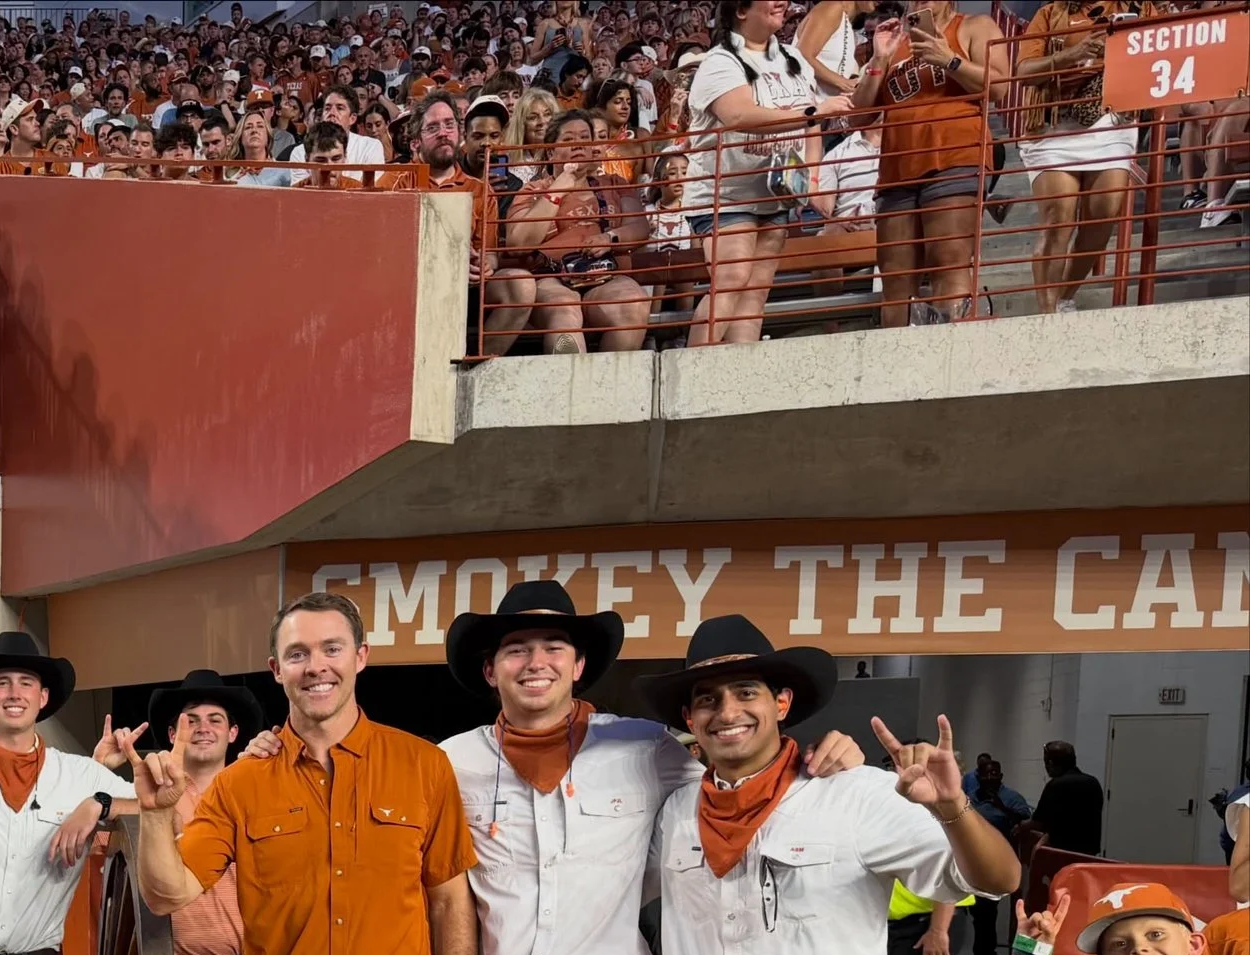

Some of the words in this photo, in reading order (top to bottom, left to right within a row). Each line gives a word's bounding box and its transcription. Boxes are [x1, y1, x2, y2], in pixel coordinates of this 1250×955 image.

[1127, 18, 1227, 56] SECTION
[1150, 55, 1196, 98] 34
[774, 539, 1006, 635] THE
[1161, 688, 1181, 702] EXIT
